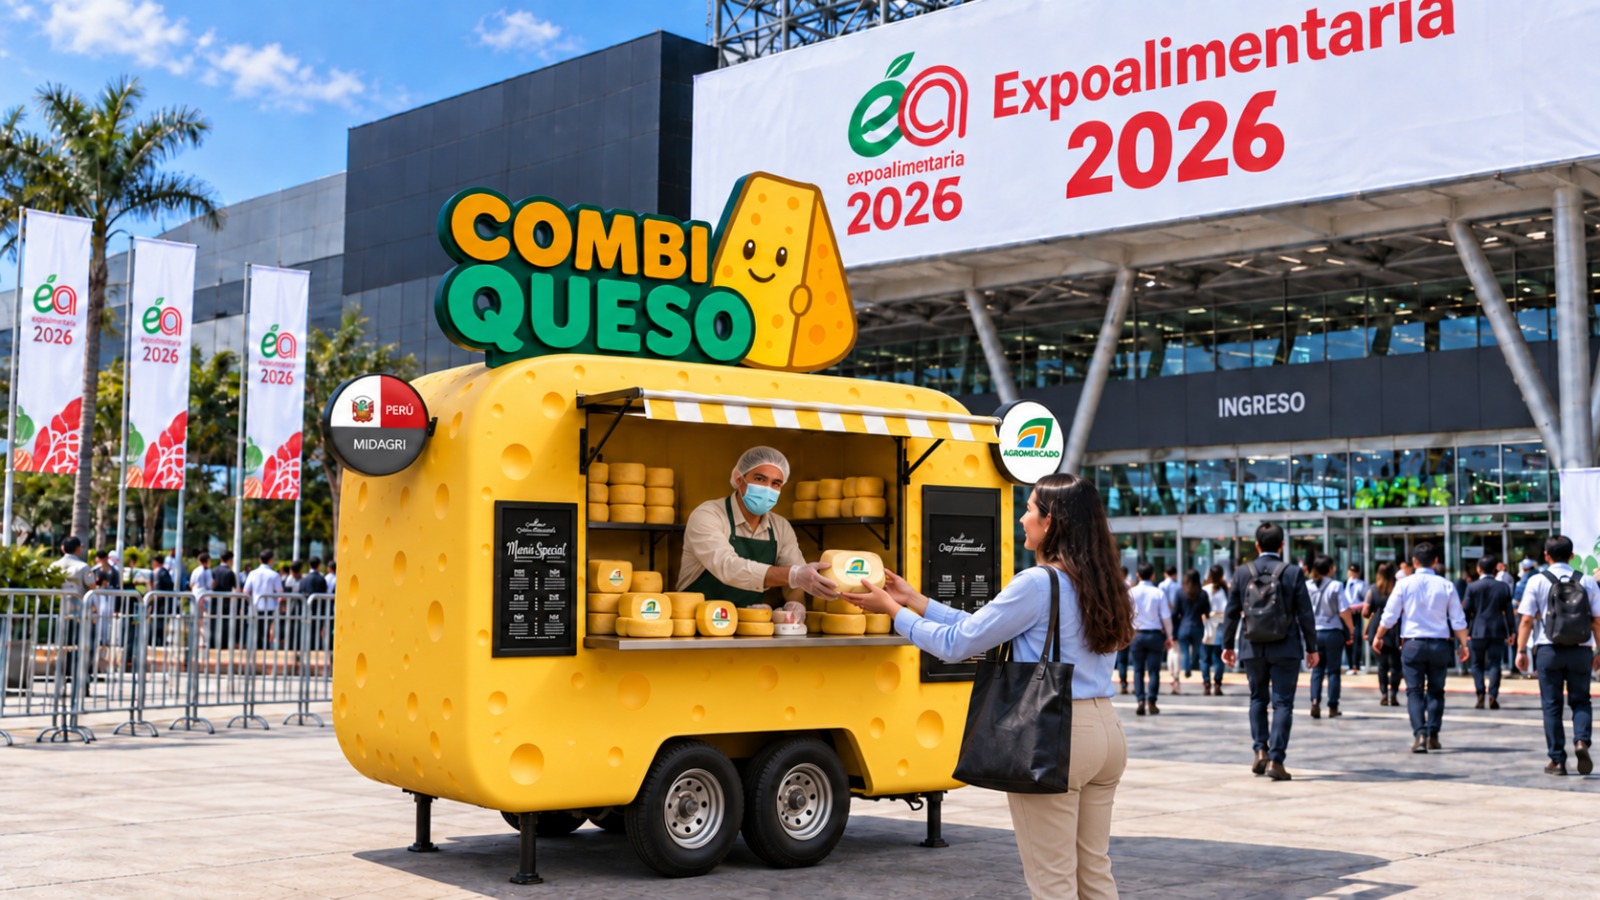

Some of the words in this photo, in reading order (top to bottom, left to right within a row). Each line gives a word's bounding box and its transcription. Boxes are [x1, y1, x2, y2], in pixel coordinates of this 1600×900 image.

[993, 0, 1456, 121] Expoalimentaria
[1066, 90, 1285, 199] 2026
[847, 176, 963, 236] 2026
[451, 193, 708, 283] COMBI
[447, 264, 754, 361] QUESO
[33, 325, 73, 346] 2026
[143, 346, 179, 364] 2026
[260, 368, 294, 385] 2026
[385, 403, 414, 416] PERÚ
[1218, 391, 1306, 418] INGRESO
[353, 438, 407, 451] MIDAGRI
[1003, 449, 1060, 458] AGROMERCADO
